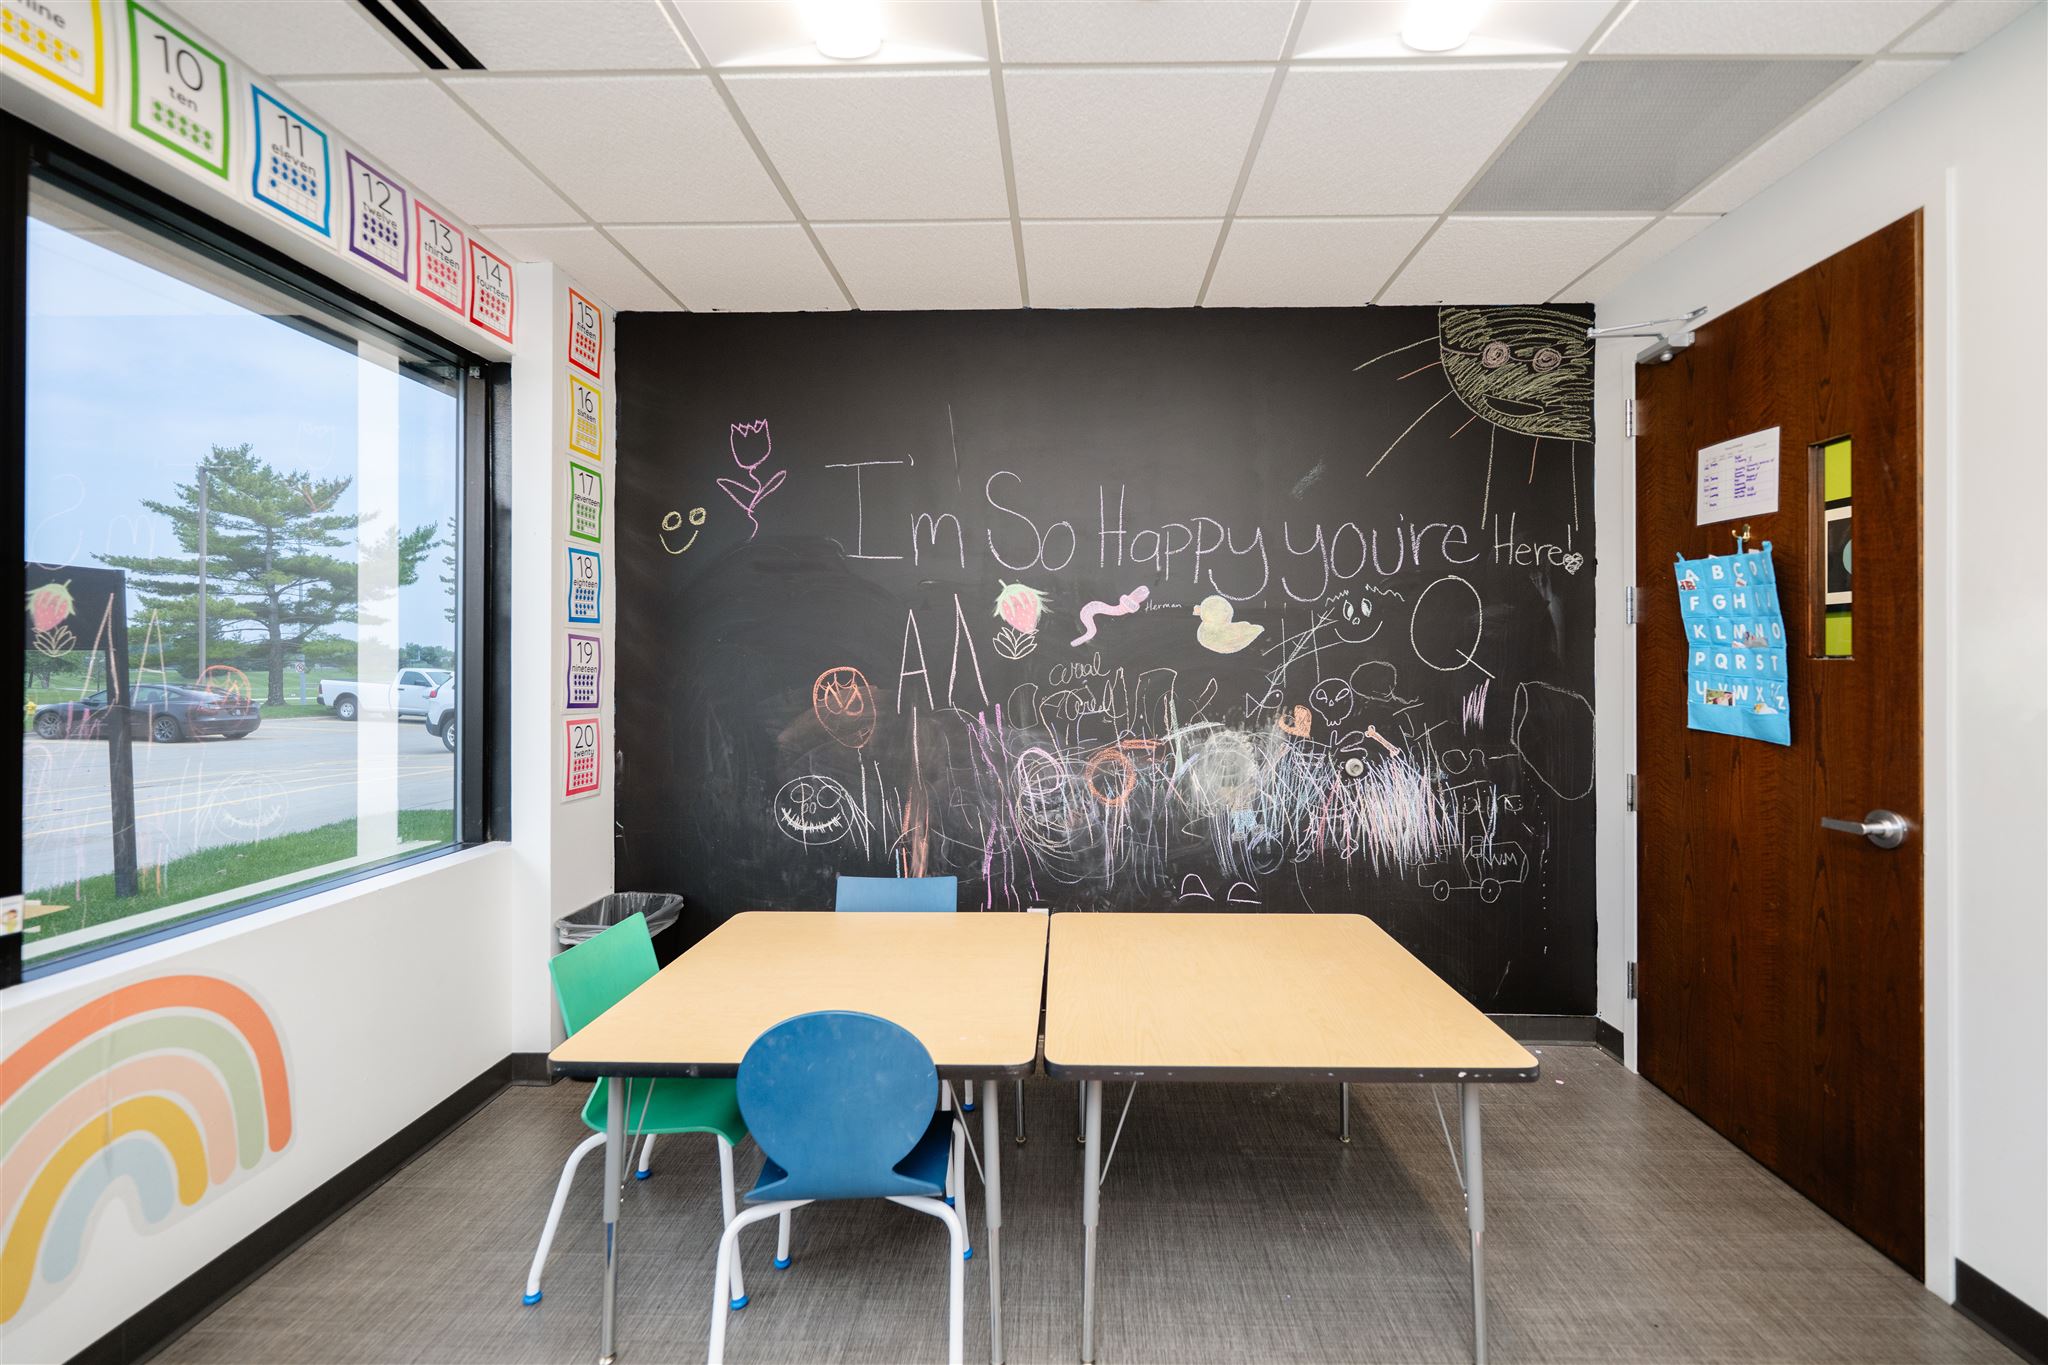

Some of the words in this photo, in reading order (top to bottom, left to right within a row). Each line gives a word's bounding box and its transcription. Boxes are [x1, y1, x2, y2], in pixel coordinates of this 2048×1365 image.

[154, 35, 203, 91] 10
[169, 86, 198, 112] ten
[278, 115, 304, 157] 11
[272, 144, 317, 177] eleven
[363, 173, 393, 215] 12
[363, 202, 398, 230] twelve
[429, 219, 453, 254] 13
[425, 241, 460, 270] thirteen
[481, 255, 502, 287] 14
[476, 275, 510, 302] fourteen
[578, 301, 594, 329] 15
[577, 322, 597, 341] fifteen
[578, 387, 594, 413] 16
[577, 408, 597, 424] sixteen
[579, 472, 594, 496] 17
[574, 493, 600, 508] seventeen
[825, 454, 965, 568] I'm
[986, 471, 1075, 571] So
[1099, 484, 1268, 600] Happy
[1282, 514, 1480, 601] you're
[576, 556, 593, 579] 18
[1684, 569, 1699, 583] A
[1711, 565, 1724, 580] B
[1733, 562, 1744, 577] C
[573, 578, 598, 589] eighteen
[1145, 599, 1182, 613] Herman
[1690, 596, 1699, 611] F
[1712, 594, 1727, 610] G
[1733, 592, 1746, 609] H
[1693, 624, 1706, 638] K
[1715, 625, 1727, 639] L
[1733, 624, 1746, 639] M
[1772, 622, 1781, 639] O
[576, 642, 593, 664] 19
[1695, 651, 1706, 666] P
[1715, 653, 1728, 670] Q
[1735, 654, 1747, 670] R
[1756, 654, 1764, 670] S
[1771, 655, 1778, 671] T
[572, 664, 598, 674] nineteen
[1695, 680, 1707, 696] U
[1732, 685, 1748, 700] W
[1755, 686, 1765, 702] X
[1776, 696, 1786, 710] Z
[574, 725, 594, 749] 20
[573, 747, 595, 758] twenty
